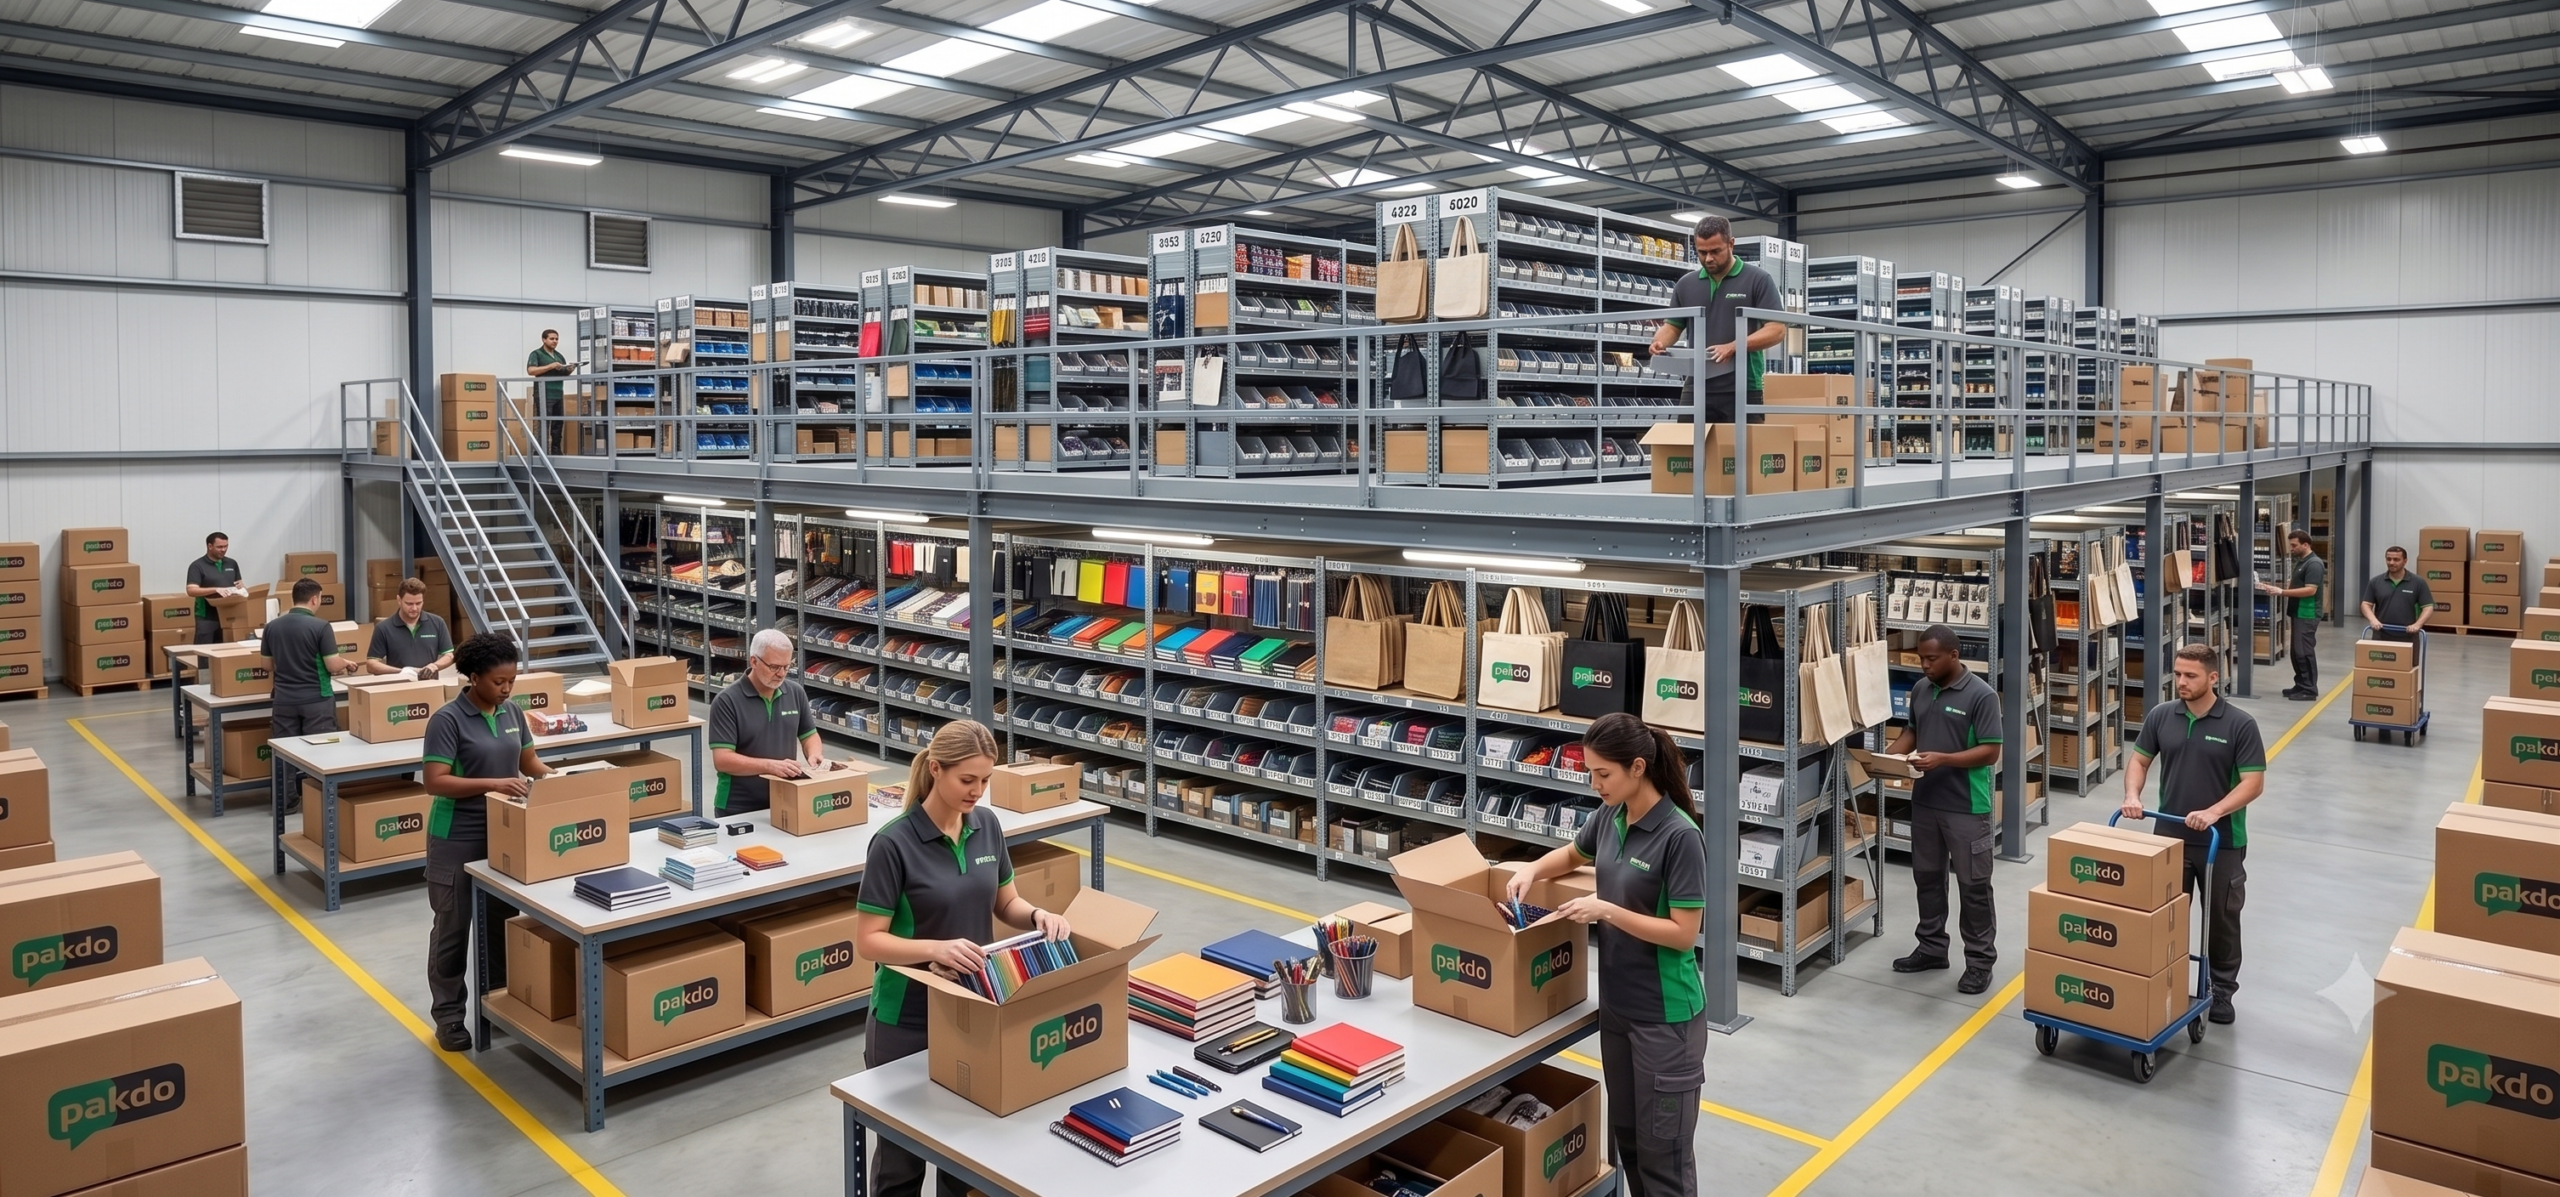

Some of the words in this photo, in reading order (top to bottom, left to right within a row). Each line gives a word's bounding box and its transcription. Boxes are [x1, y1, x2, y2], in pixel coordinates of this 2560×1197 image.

[390, 706, 427, 720] pakdo
[2516, 739, 2560, 756] pakd
[379, 817, 420, 836] pakdo
[554, 824, 602, 850] pakdo
[2074, 860, 2121, 882] pakdo
[2064, 919, 2113, 942] pakdo
[22, 936, 111, 973] pakdo
[800, 948, 849, 977] pakdo
[1436, 951, 1487, 981] pakdo
[1534, 946, 1571, 982] pakdo
[660, 985, 714, 1016] pakdo
[2060, 979, 2110, 1004] pakdo
[1036, 1012, 1098, 1056] pakdo
[2438, 1060, 2554, 1105] pakdo
[61, 1079, 176, 1133] pakdo
